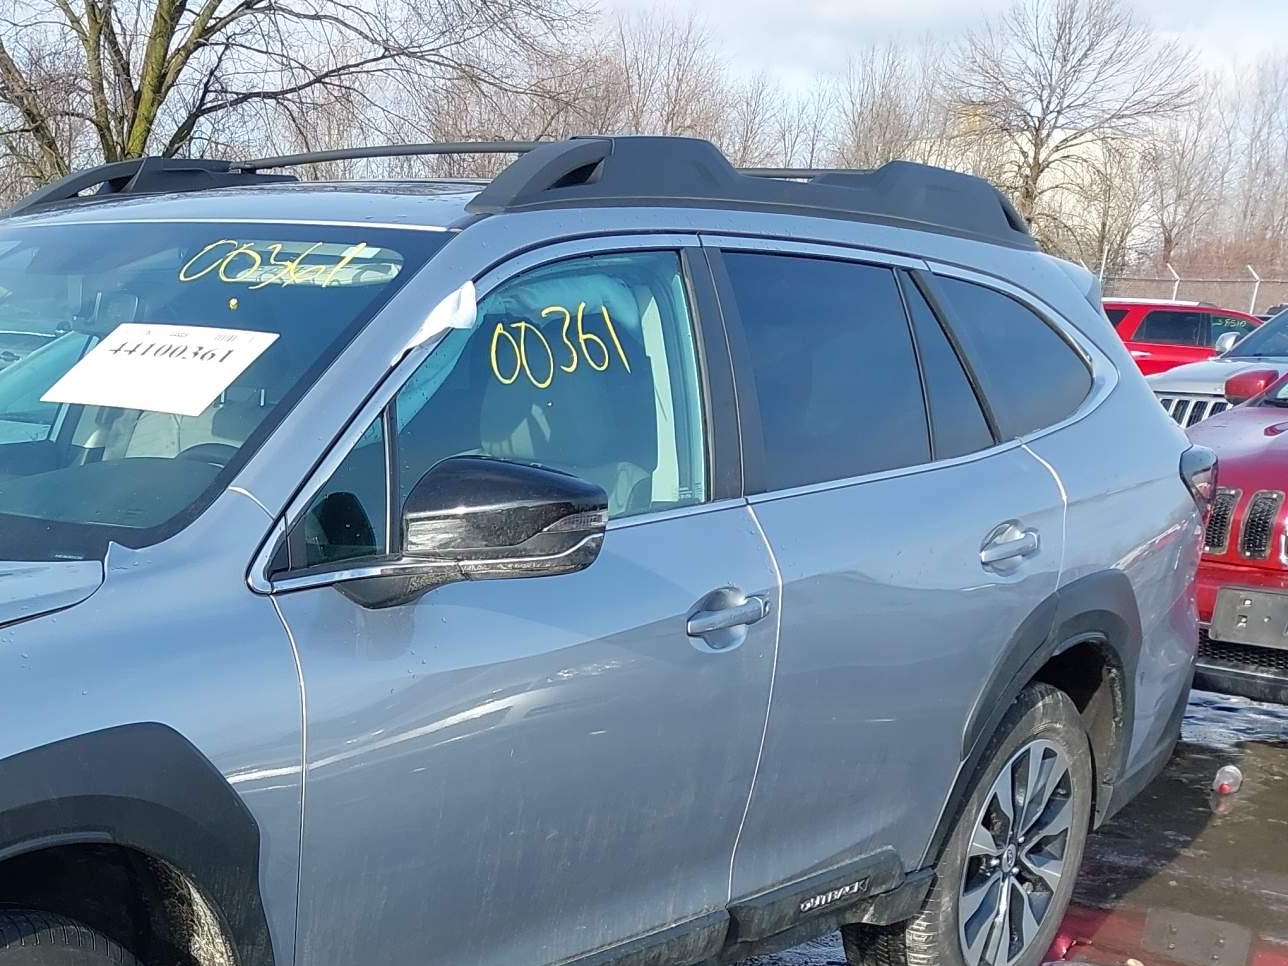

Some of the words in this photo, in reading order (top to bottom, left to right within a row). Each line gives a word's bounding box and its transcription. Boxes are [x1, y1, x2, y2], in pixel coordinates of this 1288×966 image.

[179, 239, 367, 289] 00361
[108, 342, 234, 363] 44100361
[491, 302, 631, 388] 00361
